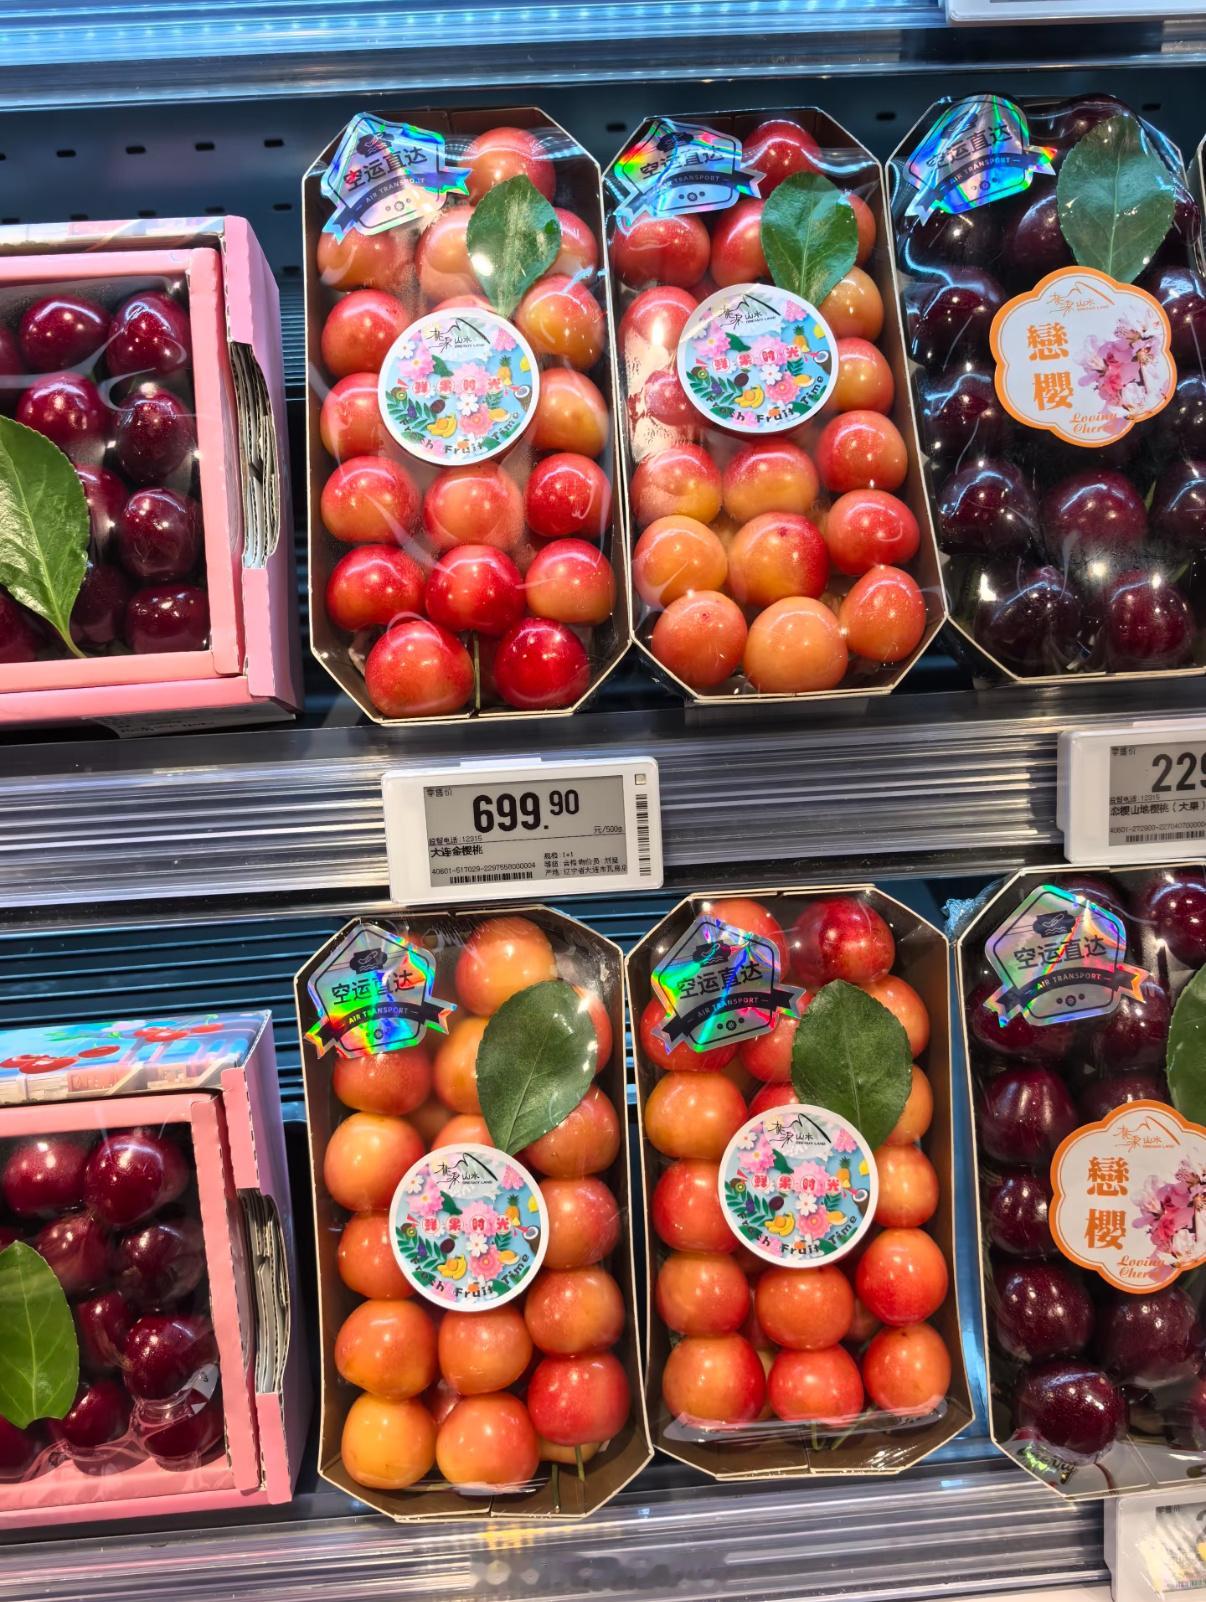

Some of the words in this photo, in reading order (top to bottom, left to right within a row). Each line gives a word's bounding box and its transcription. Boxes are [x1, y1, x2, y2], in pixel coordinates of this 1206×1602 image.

[343, 146, 428, 192] 空运直达
[640, 144, 725, 181] 空直达
[964, 157, 1011, 174] TRANSPORT
[366, 191, 379, 204] AIR
[756, 407, 794, 423] Fruit
[801, 375, 824, 405] Time
[400, 418, 434, 449] Frh
[444, 441, 484, 454] Fruit
[491, 412, 520, 440] Time
[1152, 752, 1206, 793] 22
[473, 788, 580, 834] 699.90
[430, 845, 484, 858] 大连金樱桃
[1013, 934, 1107, 970] 空运直达
[332, 969, 416, 1006] 空运直达
[676, 960, 764, 1000] 空运直达
[1036, 978, 1050, 990] AIR
[1051, 972, 1101, 983] TRANSPORT
[349, 1013, 362, 1025] AIR
[363, 1006, 409, 1019] TANSPORT
[697, 1007, 711, 1018] AIR
[712, 996, 759, 1011] TRANSPORT
[754, 1174, 840, 1191] 鲜果时光
[1084, 1157, 1129, 1250] 戀櫻
[780, 1243, 820, 1255] Fruit
[827, 1215, 857, 1246] Time
[455, 1285, 494, 1298] Fruit
[501, 1253, 529, 1284] Time
